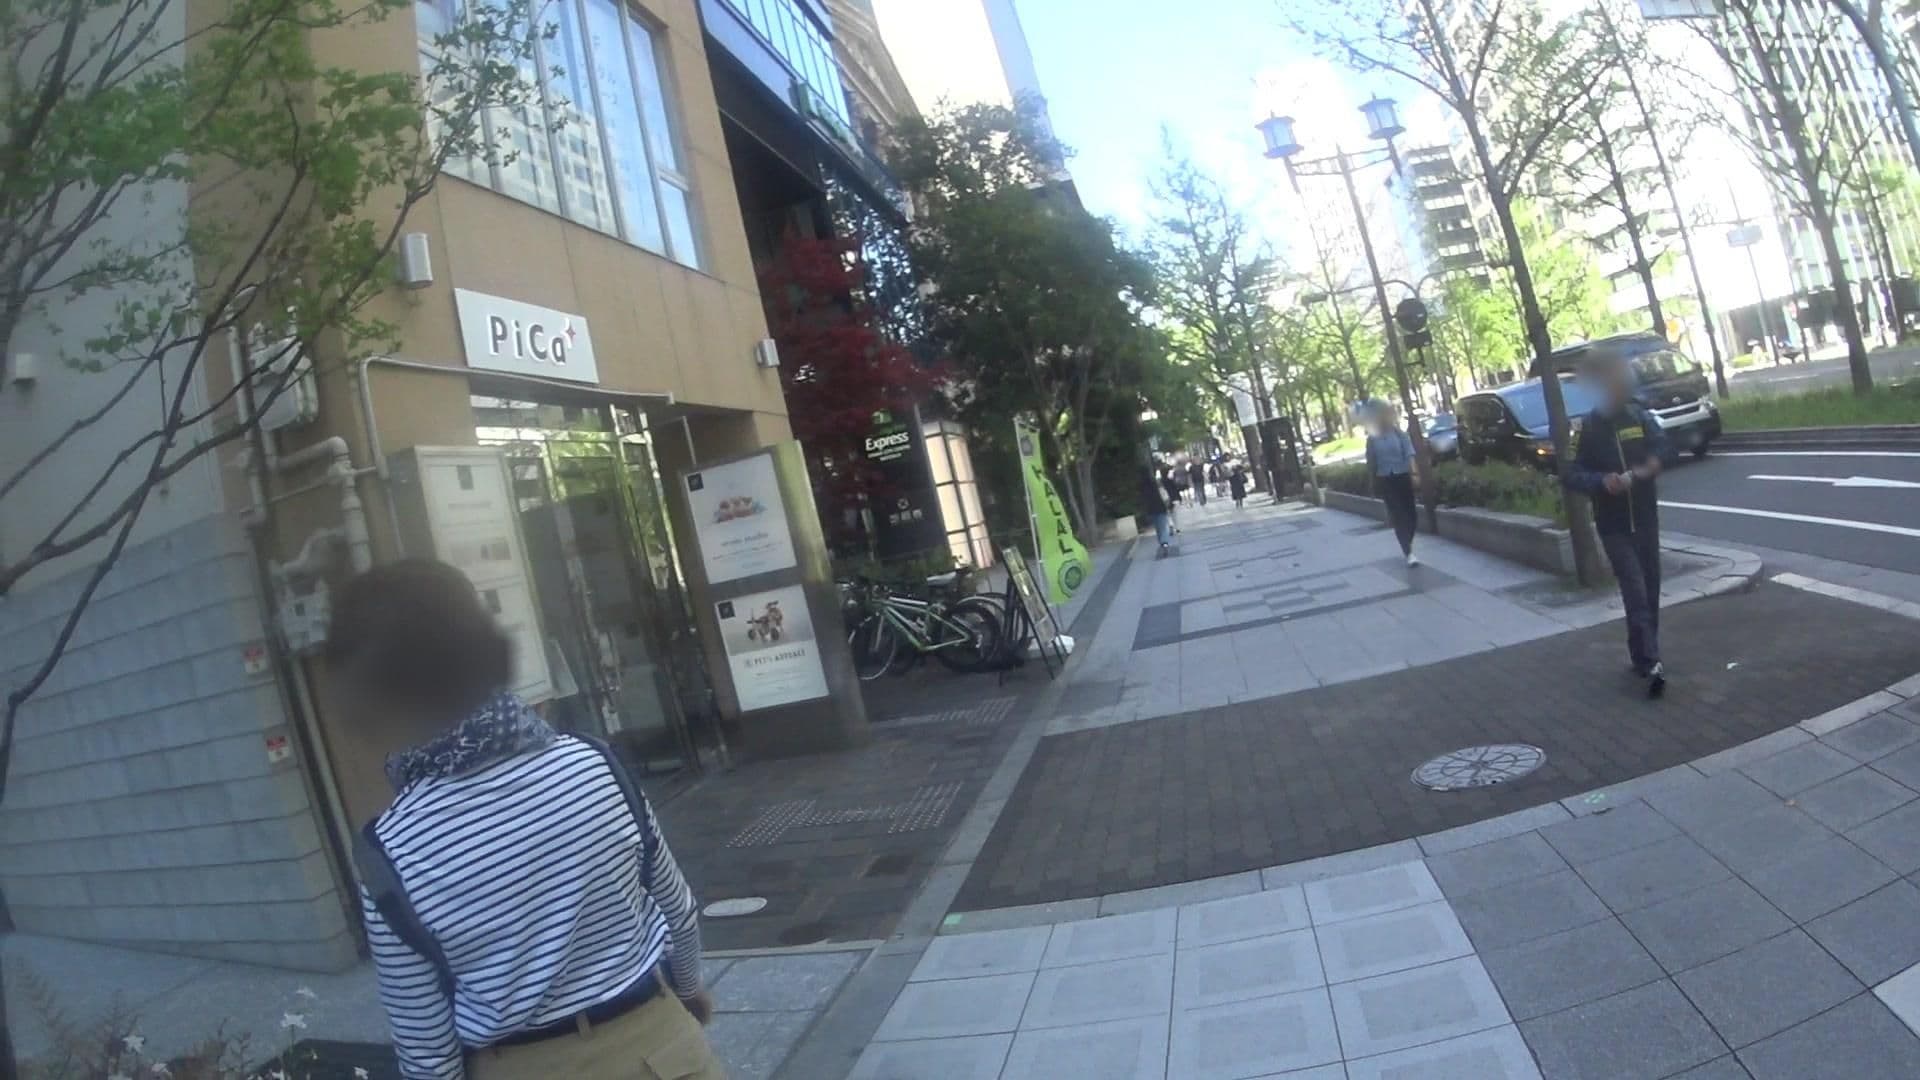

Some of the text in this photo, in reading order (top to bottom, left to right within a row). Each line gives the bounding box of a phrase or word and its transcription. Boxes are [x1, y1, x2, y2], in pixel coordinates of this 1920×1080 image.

[488, 315, 566, 365] PiCa
[865, 431, 909, 451] Express
[1032, 463, 1073, 555] HALAL
